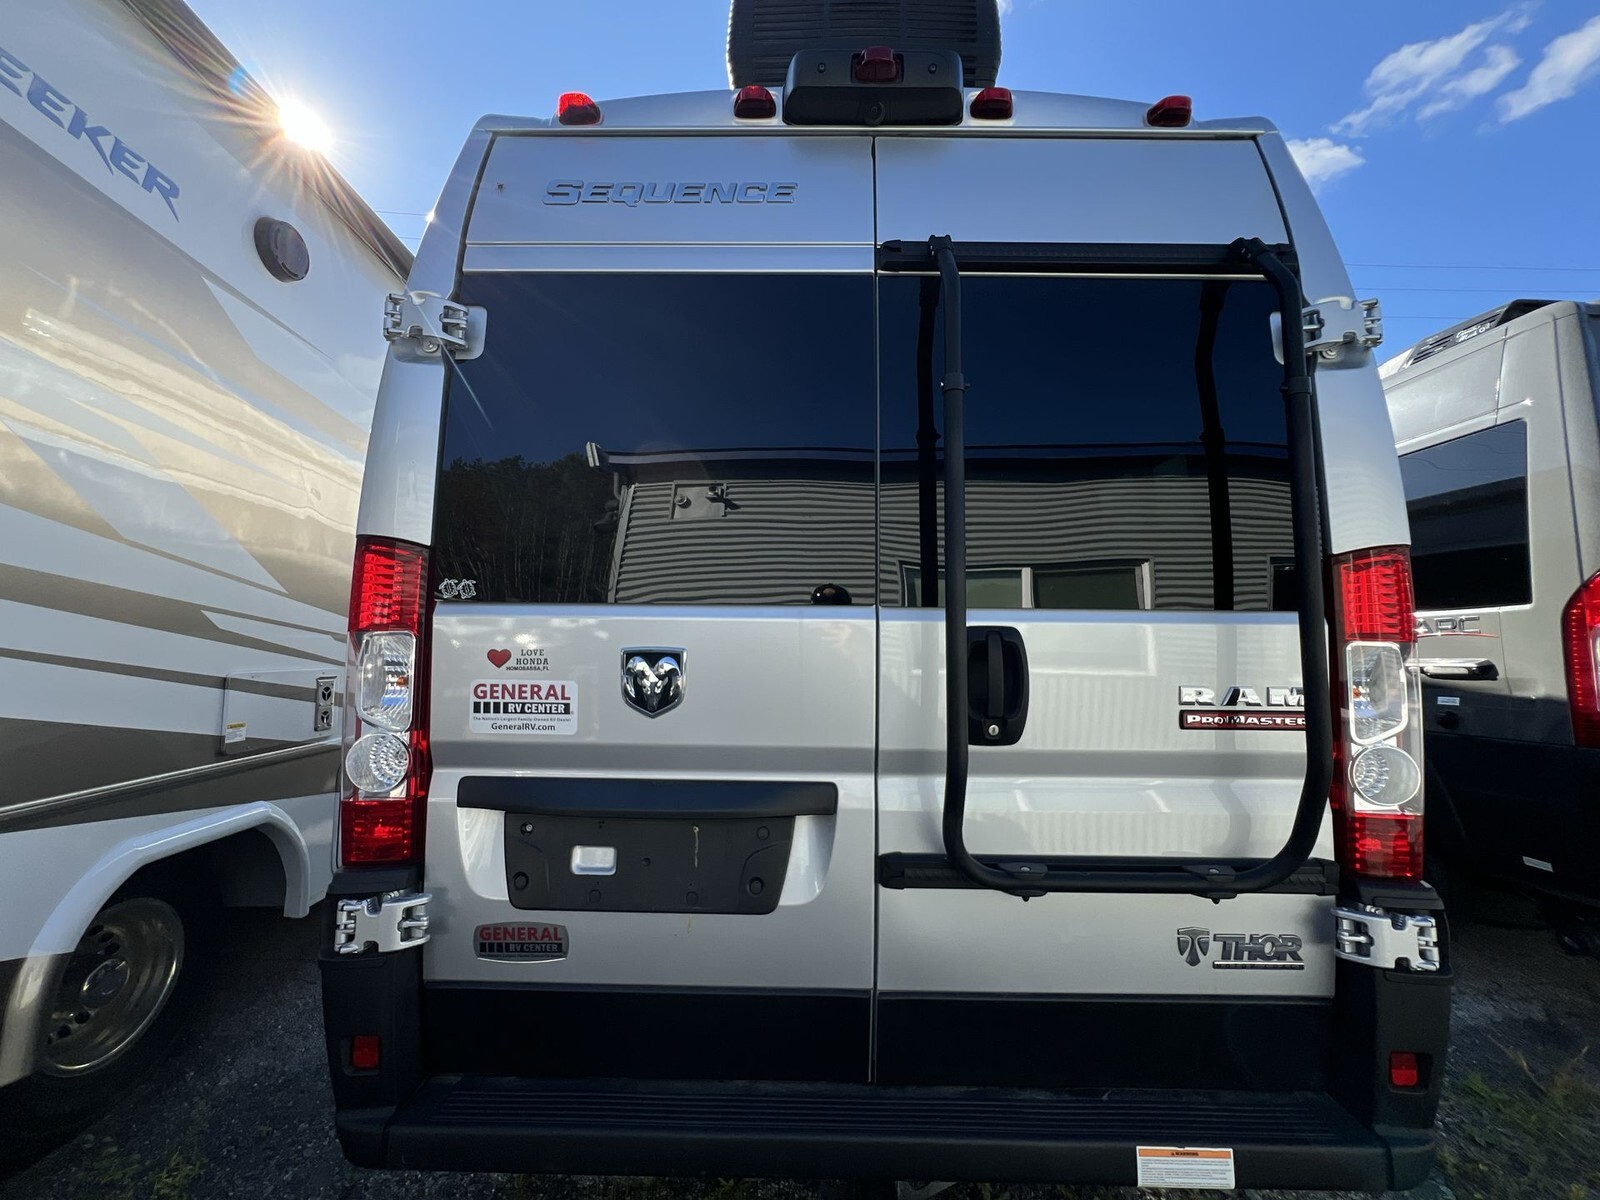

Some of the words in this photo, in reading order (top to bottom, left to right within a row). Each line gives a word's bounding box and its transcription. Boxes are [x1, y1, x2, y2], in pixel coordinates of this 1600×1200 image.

[542, 179, 798, 208] SEQUENCE
[520, 649, 545, 657] LOVE
[516, 658, 549, 666] HONDA
[473, 683, 571, 700] GENERAL
[1179, 685, 1304, 706] RAM
[508, 703, 522, 713] RV
[524, 703, 565, 714] CENTER
[491, 722, 556, 731] GeneralRV.com
[480, 926, 562, 941] GENERAL
[509, 943, 521, 952] RV
[523, 943, 558, 952] CENTER
[1213, 933, 1304, 961] THOR
